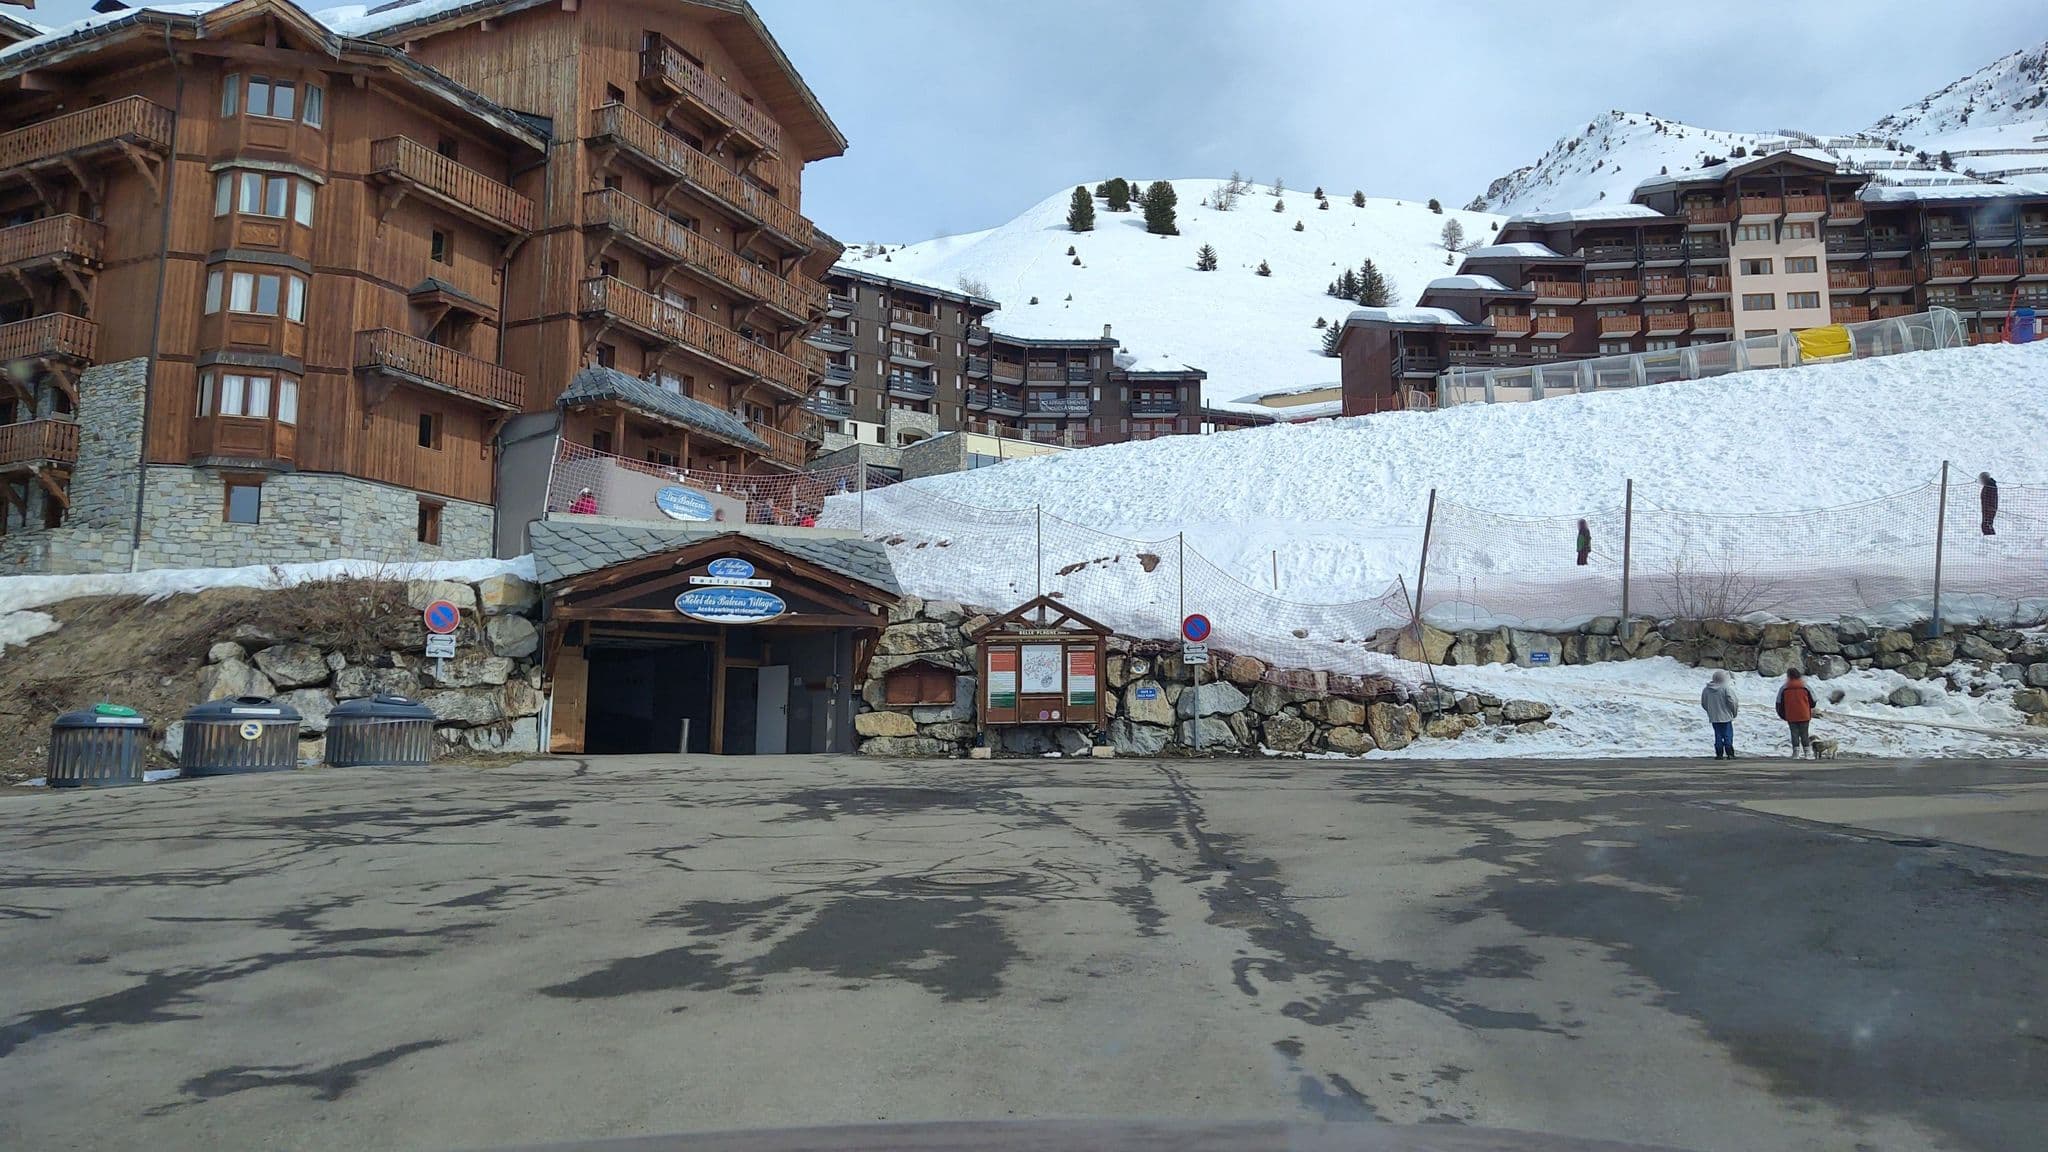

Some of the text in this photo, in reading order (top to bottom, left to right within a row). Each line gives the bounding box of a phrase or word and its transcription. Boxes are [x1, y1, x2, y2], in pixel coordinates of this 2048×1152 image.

[704, 595, 716, 605] des
[717, 595, 746, 607] Balcons
[748, 597, 773, 611] Village
